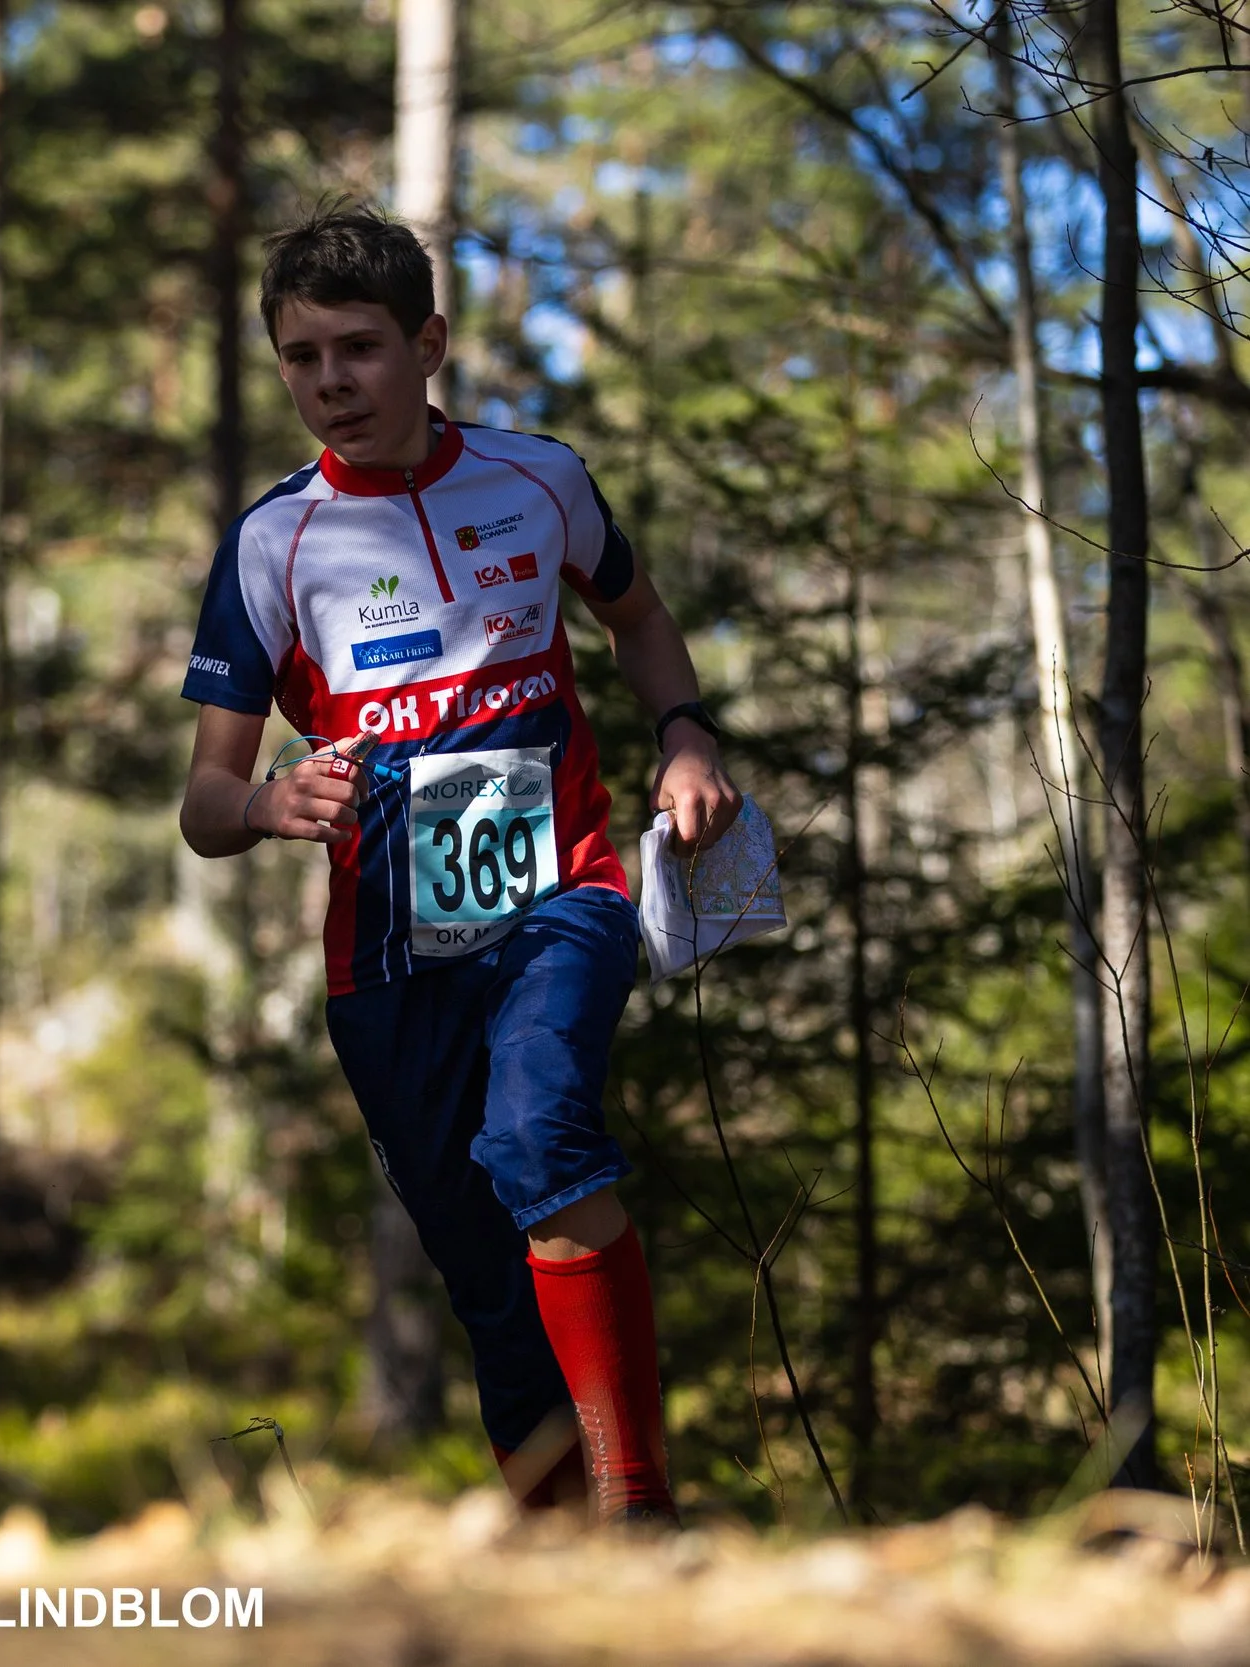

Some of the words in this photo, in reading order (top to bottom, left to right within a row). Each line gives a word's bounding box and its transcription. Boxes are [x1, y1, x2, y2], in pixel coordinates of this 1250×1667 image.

[476, 513, 524, 532] HALLSBERGS
[479, 524, 518, 541] KOMMUN
[474, 564, 508, 584] ICA
[358, 600, 420, 623] Kumla
[487, 615, 516, 634] ICA
[367, 655, 380, 664] AB
[358, 695, 420, 735] OK
[430, 670, 556, 722] Tisaren
[423, 779, 507, 801] NOREX
[432, 817, 537, 912] 369
[436, 928, 467, 945] OK
